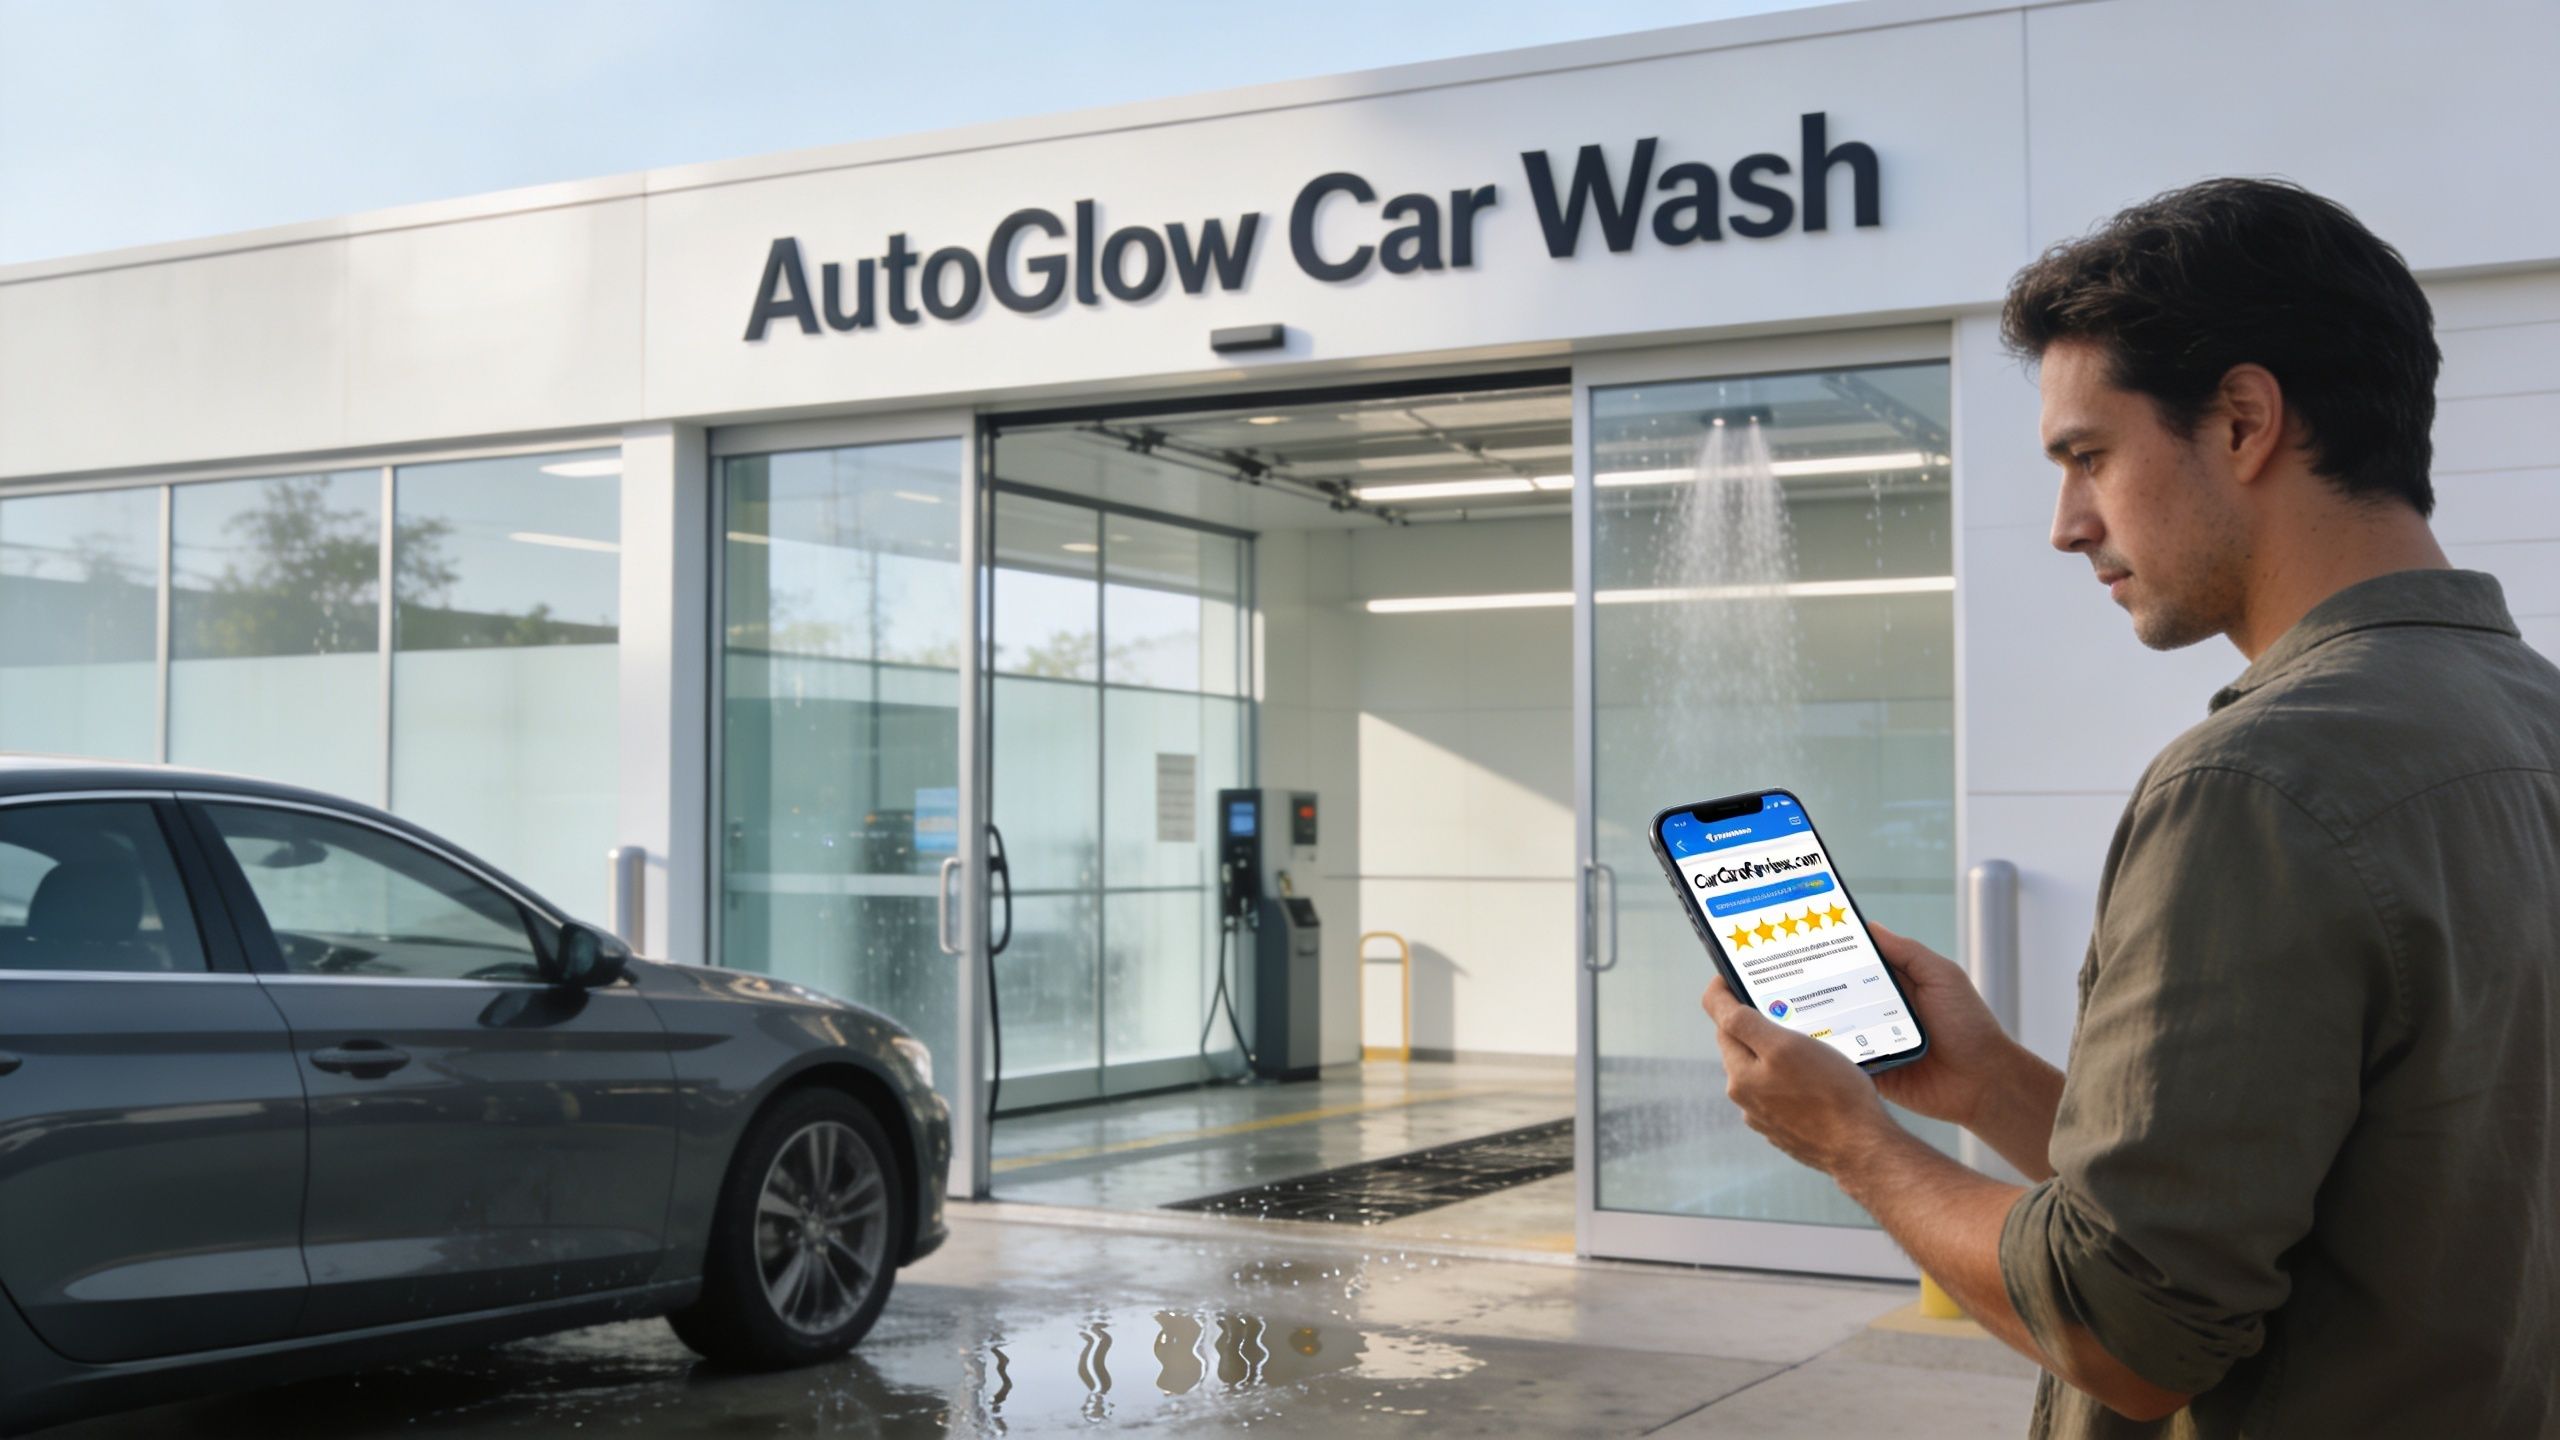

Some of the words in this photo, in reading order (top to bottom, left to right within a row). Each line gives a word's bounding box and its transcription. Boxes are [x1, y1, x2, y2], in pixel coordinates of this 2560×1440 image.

[744, 199, 1260, 341] AutoGlow
[1289, 171, 1497, 282] Car
[1520, 111, 1882, 259] Wash
